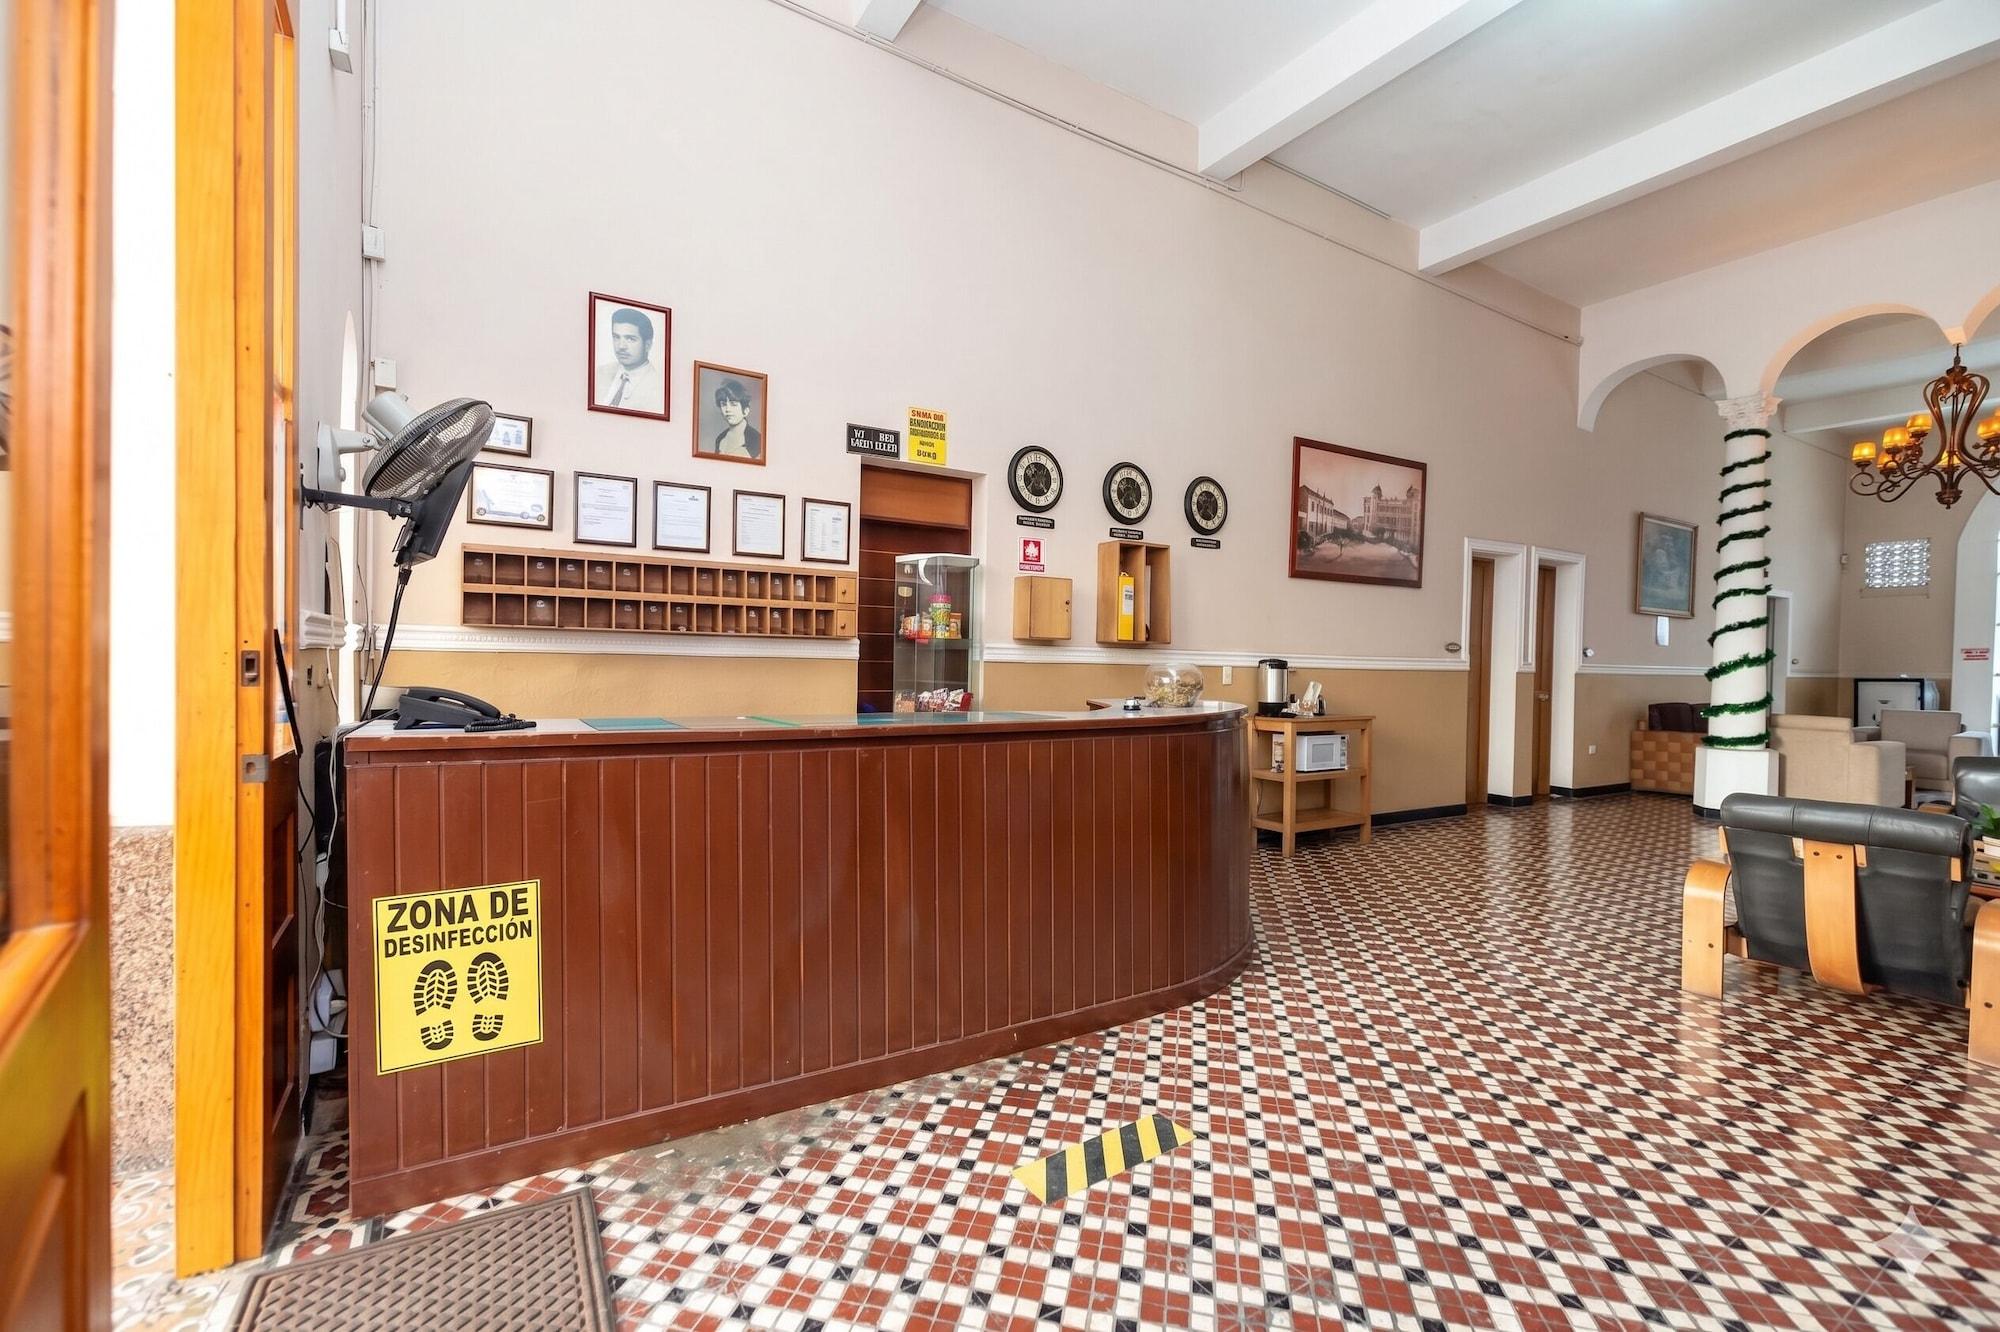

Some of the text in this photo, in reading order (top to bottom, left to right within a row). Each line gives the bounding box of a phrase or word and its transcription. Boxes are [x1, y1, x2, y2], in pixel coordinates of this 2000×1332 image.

[387, 887, 529, 933] ZONA DE
[384, 917, 532, 958] DESINFECCIÓN
